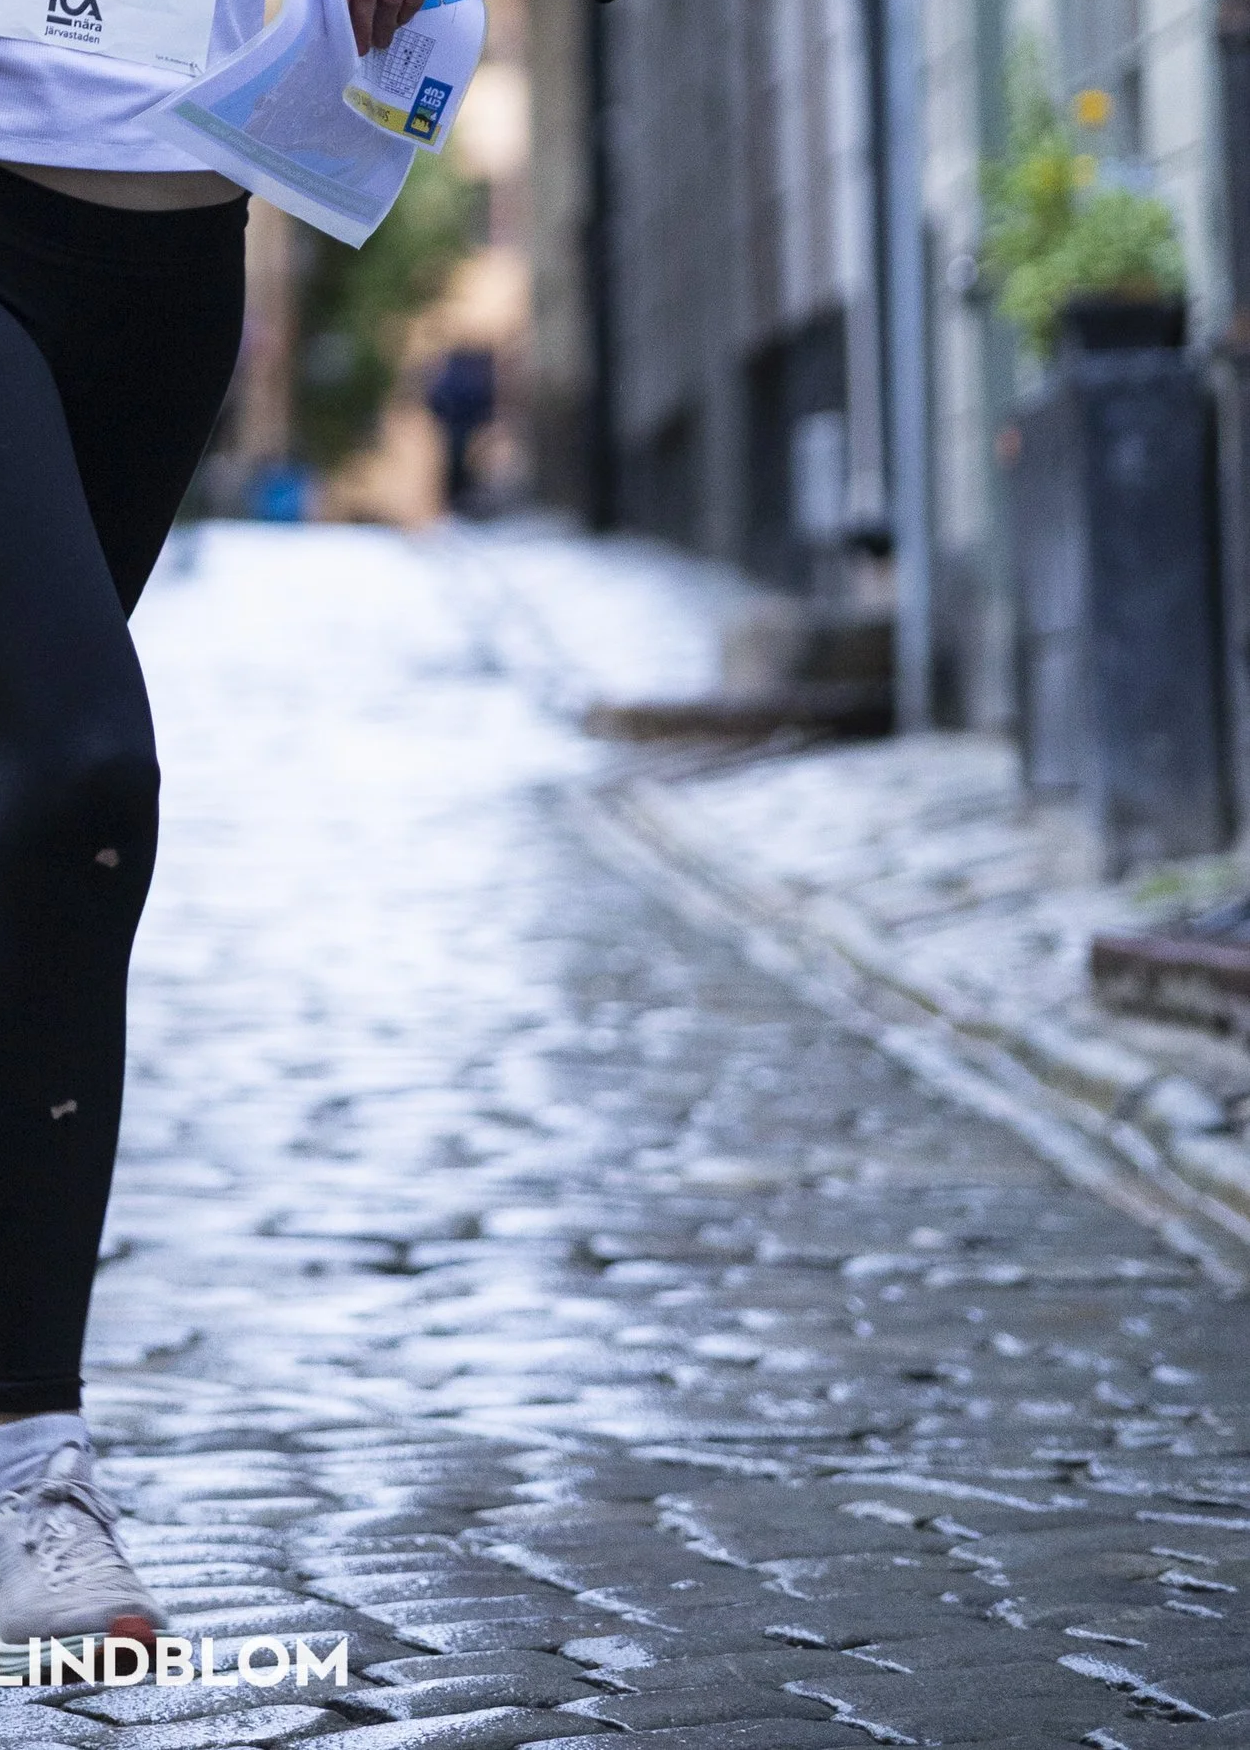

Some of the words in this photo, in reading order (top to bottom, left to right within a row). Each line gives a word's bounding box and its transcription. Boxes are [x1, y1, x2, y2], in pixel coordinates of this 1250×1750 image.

[73, 18, 102, 32] nära
[44, 26, 100, 44] Järvastaden
[424, 86, 446, 99] CUP
[420, 95, 442, 107] CITY
